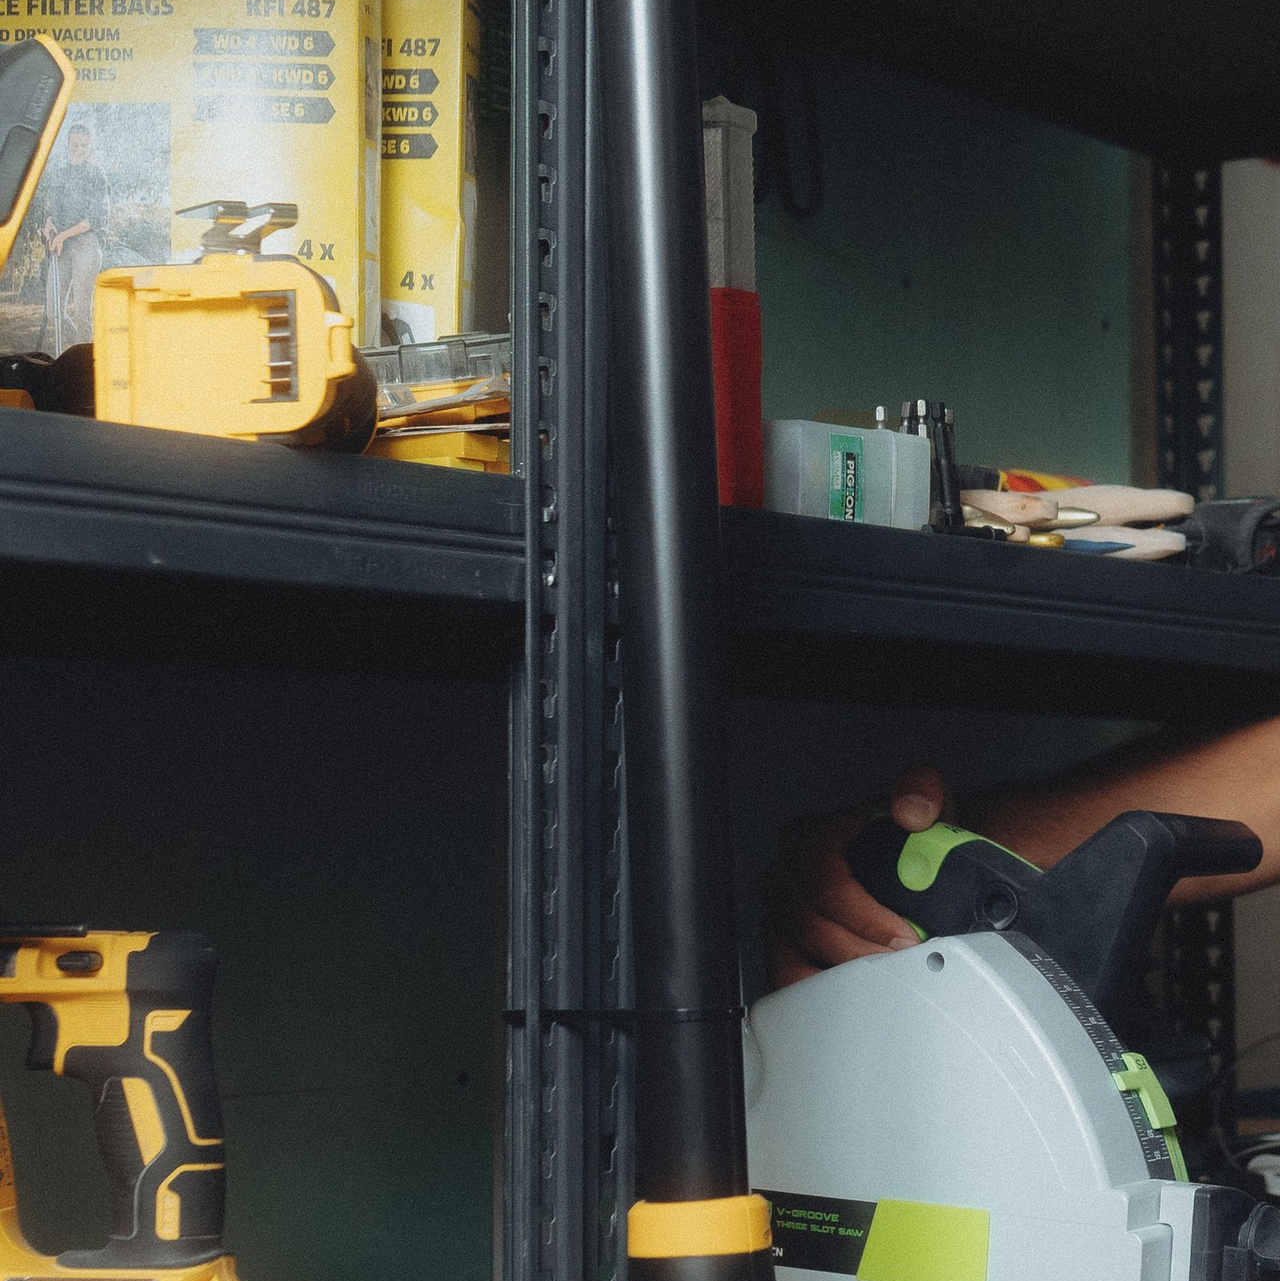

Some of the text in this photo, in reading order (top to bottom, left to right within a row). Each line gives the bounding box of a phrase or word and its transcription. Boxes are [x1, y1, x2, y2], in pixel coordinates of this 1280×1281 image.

[291, 0, 336, 18] 487
[52, 28, 120, 42] VACUUM
[270, 36, 314, 52] WD 6
[399, 38, 441, 57] 487
[272, 70, 329, 85] KWD 6
[410, 75, 419, 90] 6
[270, 103, 290, 117] SE
[294, 104, 305, 118] 6
[422, 107, 433, 120] 6
[400, 140, 410, 154] 6
[298, 239, 314, 261] 4
[400, 271, 415, 291] 4
[776, 1207, 839, 1222] V-GROOVE
[810, 1224, 835, 1234] SLOT
[838, 1228, 864, 1237] SAW
